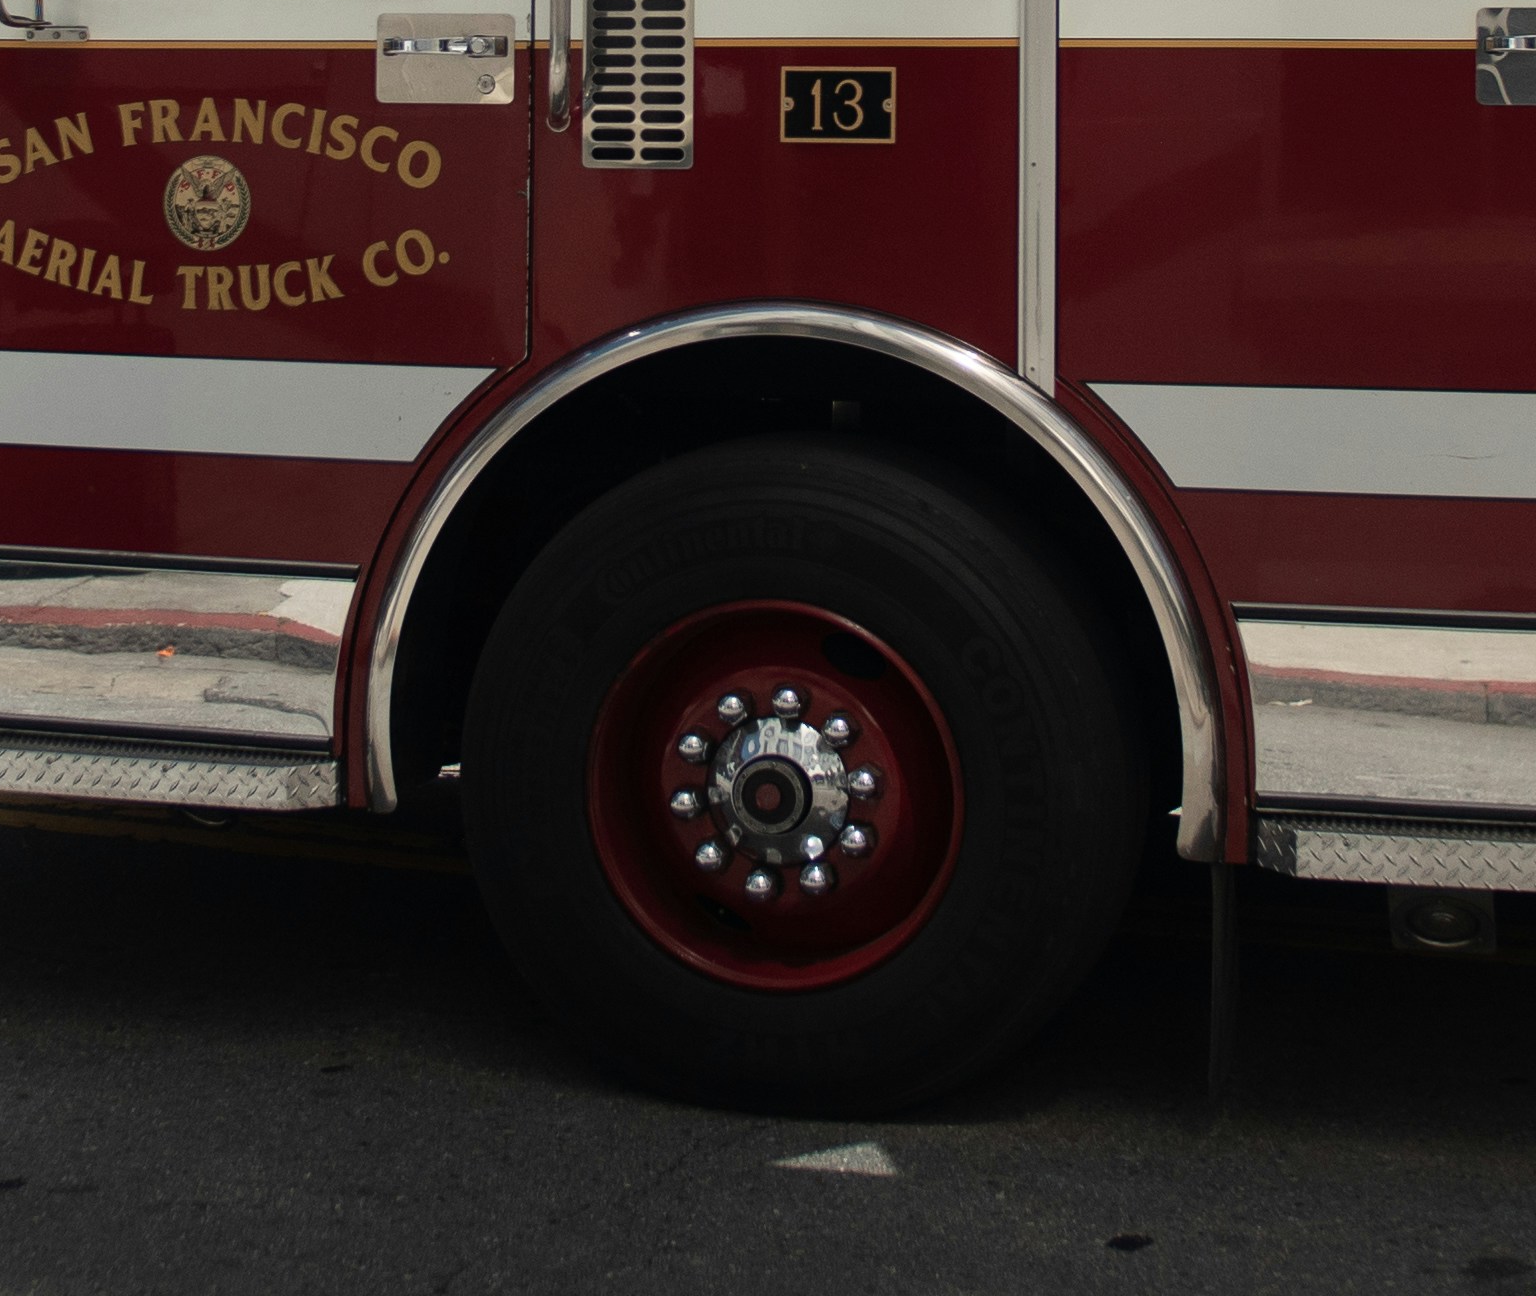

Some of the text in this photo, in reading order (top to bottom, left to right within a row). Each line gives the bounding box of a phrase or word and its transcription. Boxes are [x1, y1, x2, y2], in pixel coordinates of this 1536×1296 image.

[118, 97, 442, 189] FRANCISCO
[810, 79, 864, 131] 13
[176, 254, 345, 311] TRUCK
[363, 229, 450, 287] CO.
